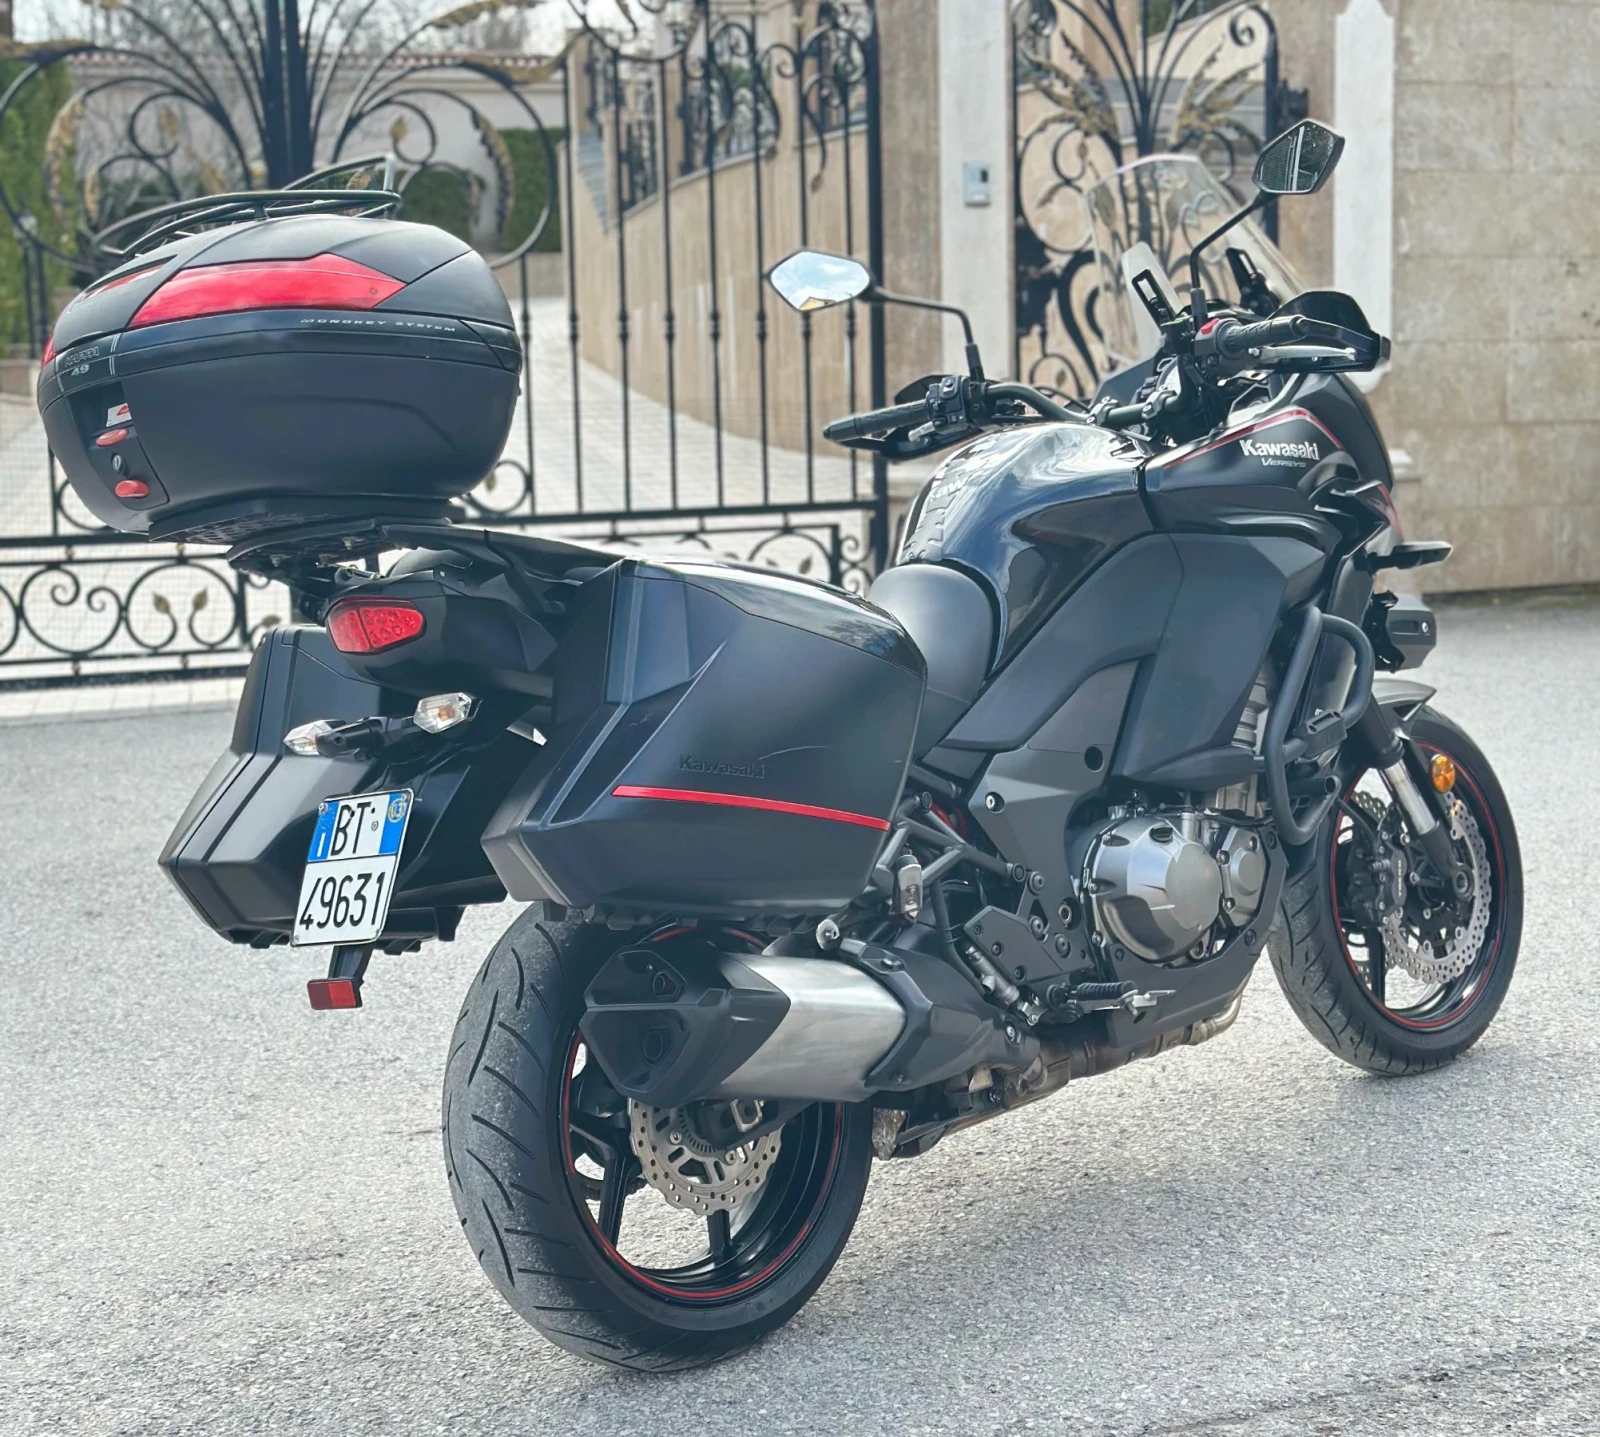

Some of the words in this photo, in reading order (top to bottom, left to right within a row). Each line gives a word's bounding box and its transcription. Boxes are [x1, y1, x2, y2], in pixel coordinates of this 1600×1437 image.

[300, 318, 387, 326] MONOKEY
[395, 321, 456, 332] SYSTEM
[71, 364, 90, 377] 49
[1239, 439, 1320, 461] Kawasaki
[679, 754, 765, 779] Kawasaki
[330, 801, 372, 857] BT
[299, 871, 386, 931] 49631
